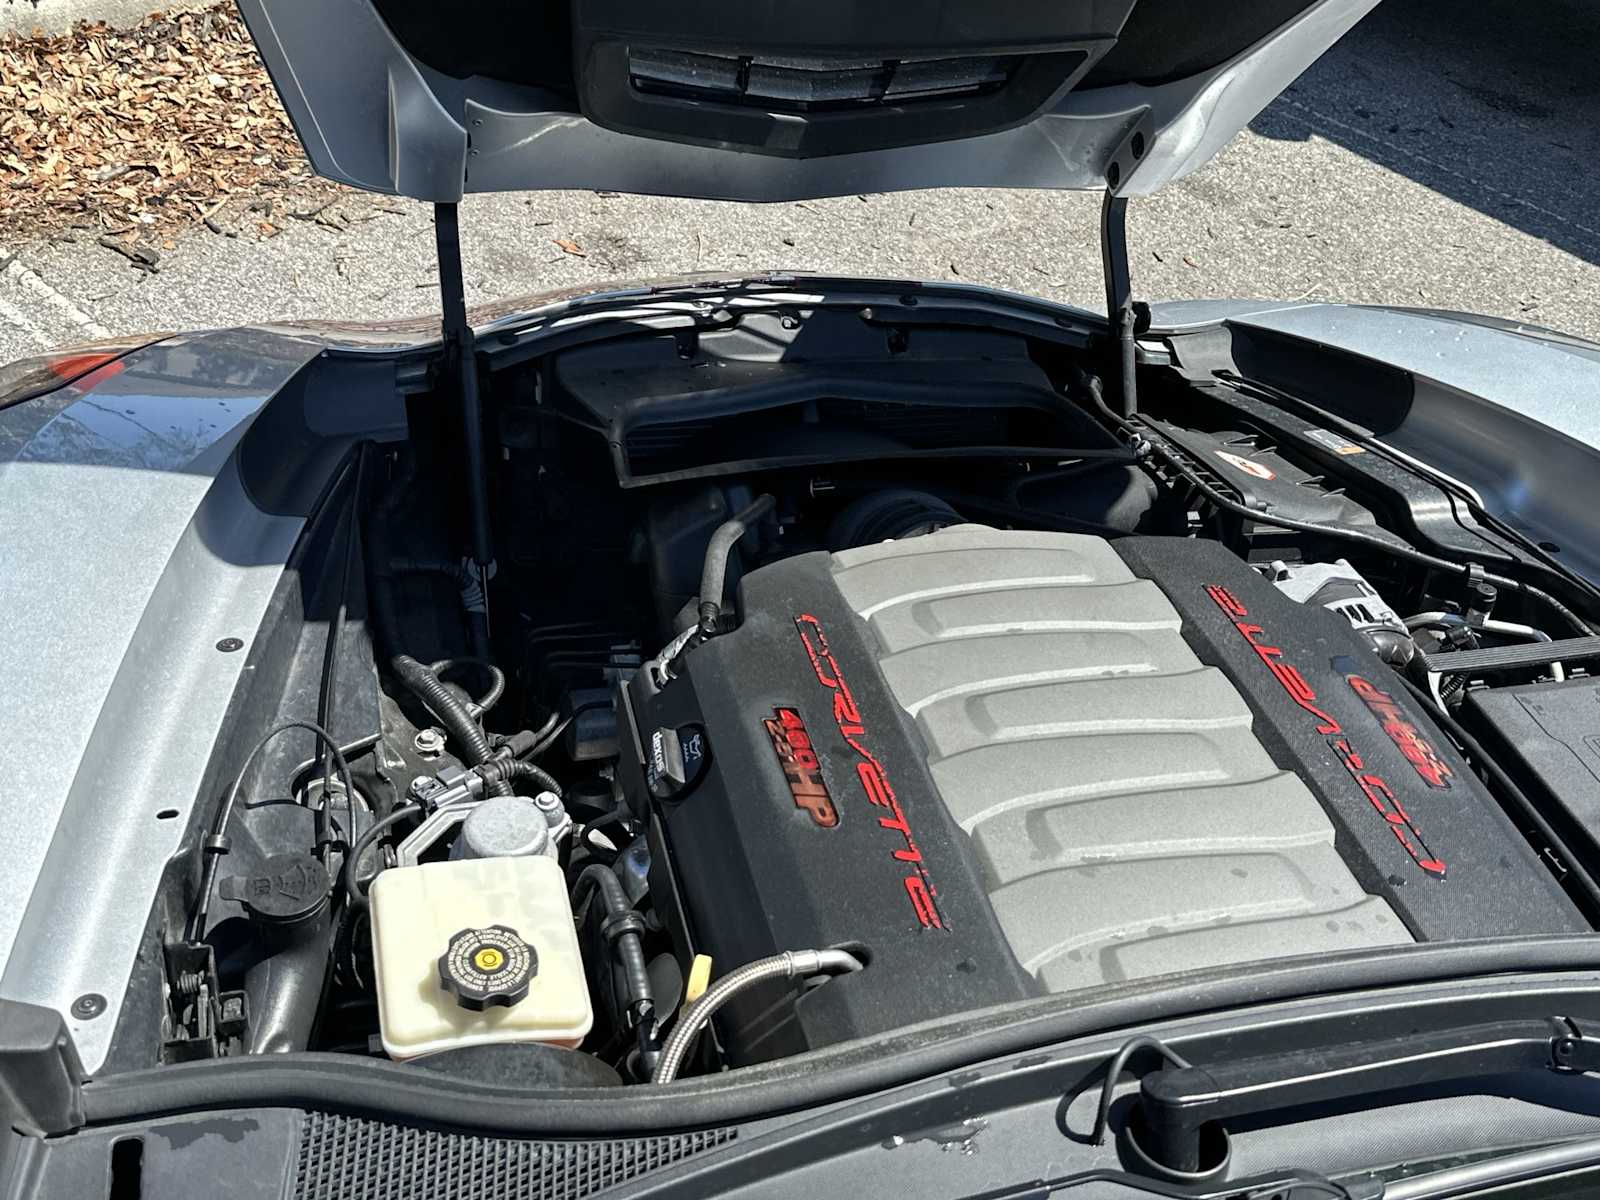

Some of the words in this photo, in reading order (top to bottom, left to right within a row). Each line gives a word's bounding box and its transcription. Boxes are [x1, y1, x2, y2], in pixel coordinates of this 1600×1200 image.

[652, 731, 665, 773] dexos
[794, 613, 949, 930] CORVETTE
[1203, 584, 1447, 877] CORVETTE
